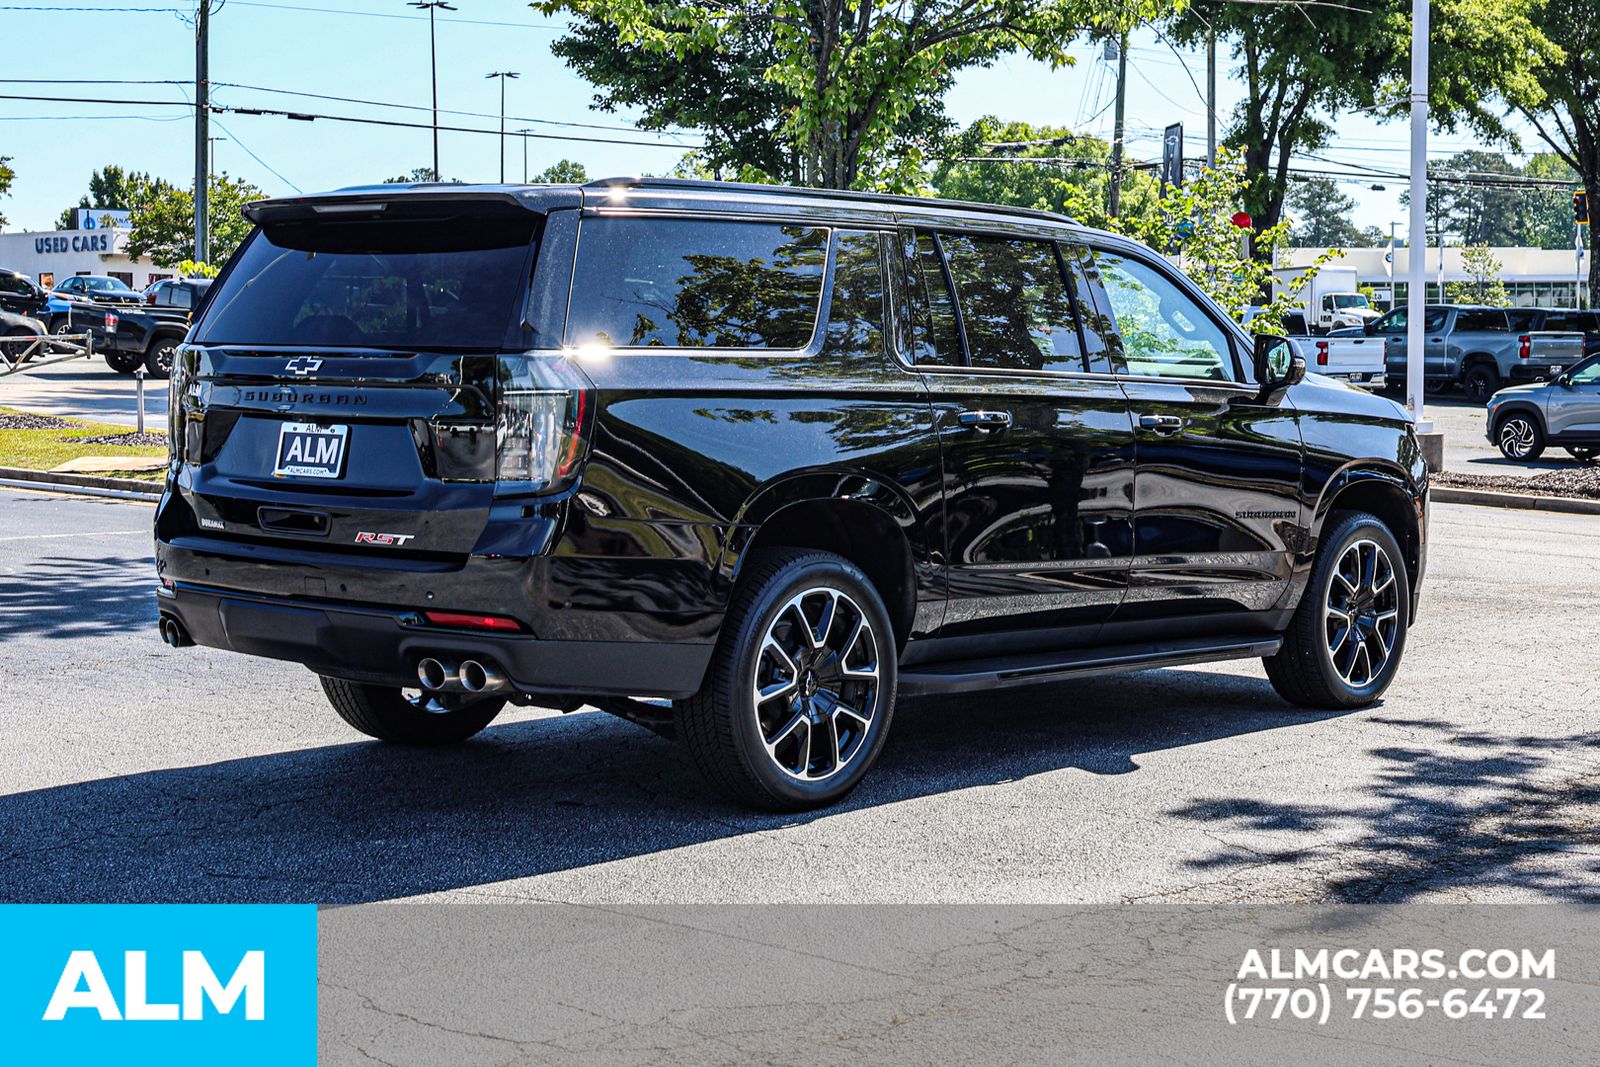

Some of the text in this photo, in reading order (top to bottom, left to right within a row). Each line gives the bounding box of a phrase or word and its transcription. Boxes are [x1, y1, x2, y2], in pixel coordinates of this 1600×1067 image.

[35, 234, 107, 254] USED CARS
[244, 391, 368, 405] SUBURBAN
[306, 424, 323, 433] ALM
[285, 435, 340, 465] ALM
[289, 467, 324, 476] ALMCARS.COM
[355, 531, 415, 546] RST
